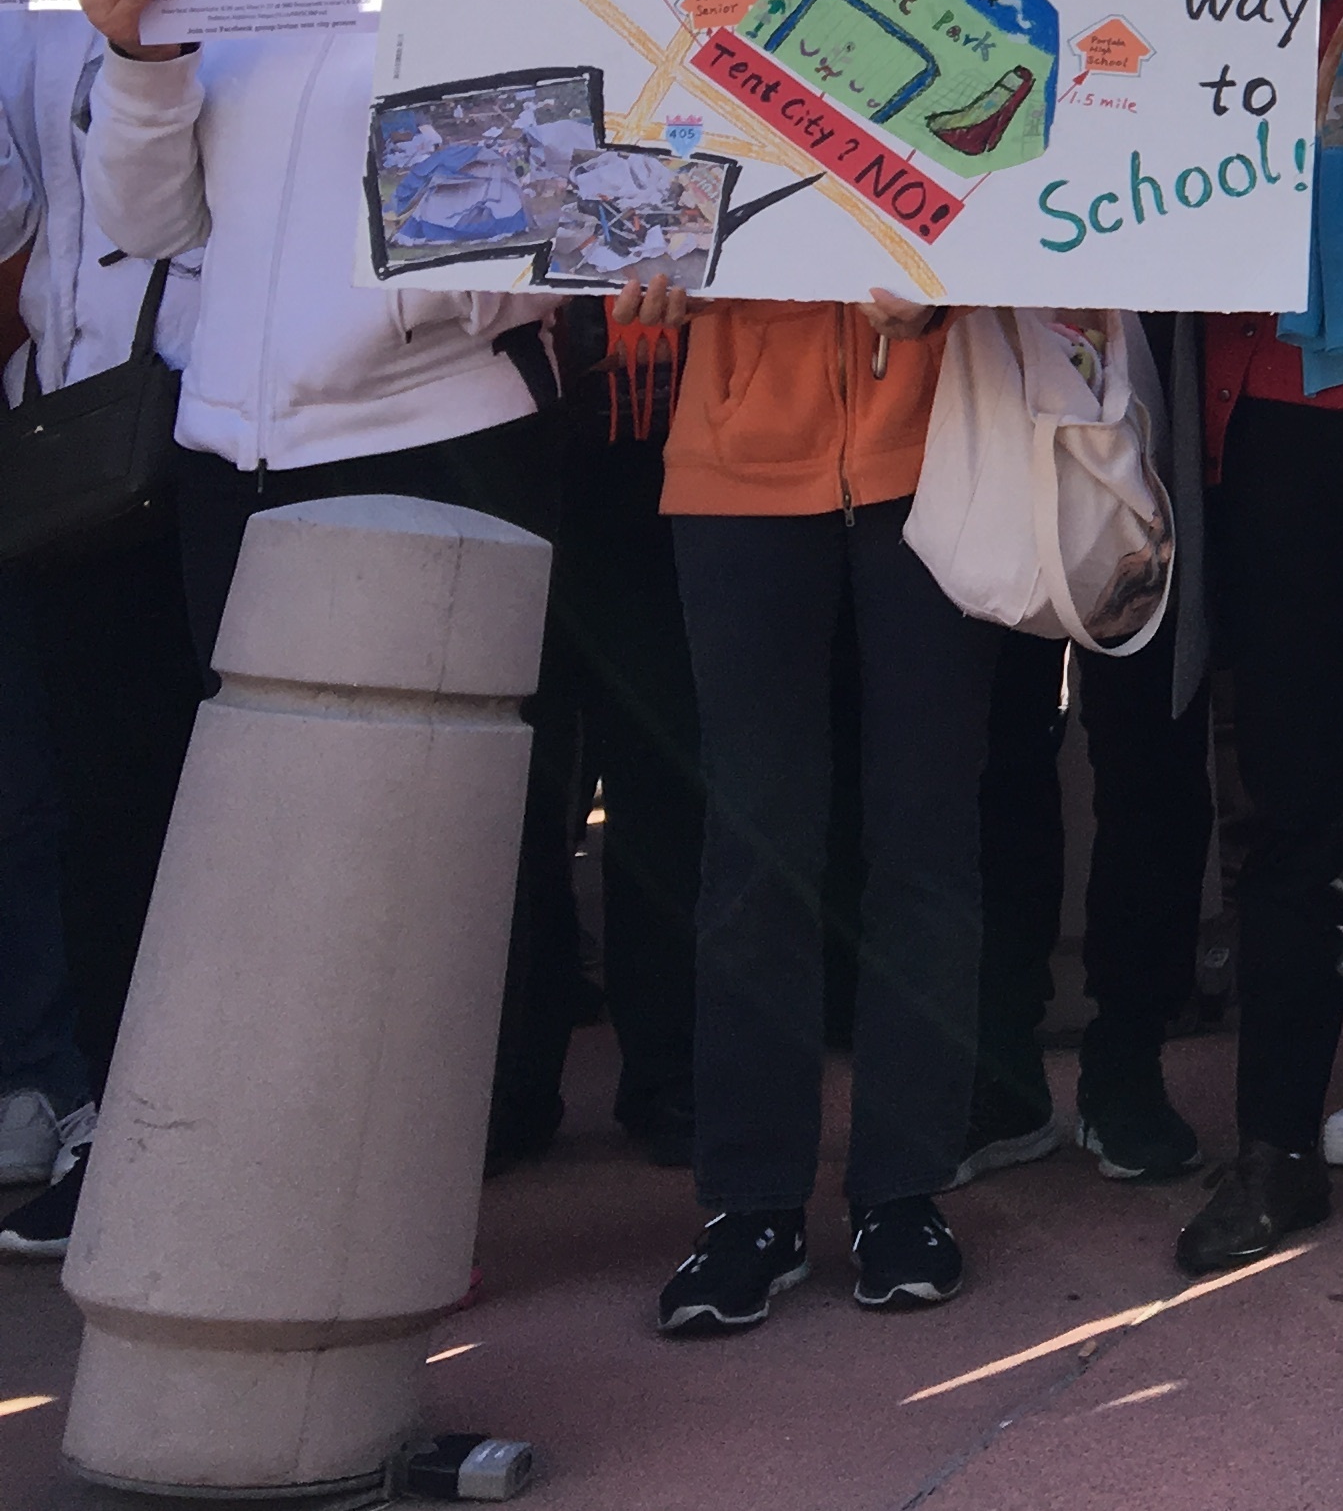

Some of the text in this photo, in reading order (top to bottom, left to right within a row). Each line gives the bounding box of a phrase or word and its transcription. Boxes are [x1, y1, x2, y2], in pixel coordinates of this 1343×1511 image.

[695, 3, 738, 17] Senior
[932, 10, 996, 62] Park
[1088, 56, 1128, 67] School
[1069, 91, 1137, 114] 1.5 mile
[1199, 63, 1279, 117] to
[669, 128, 695, 139] 405
[710, 43, 781, 103] Tent
[854, 153, 950, 237] NO!
[1038, 119, 1308, 254] School!
